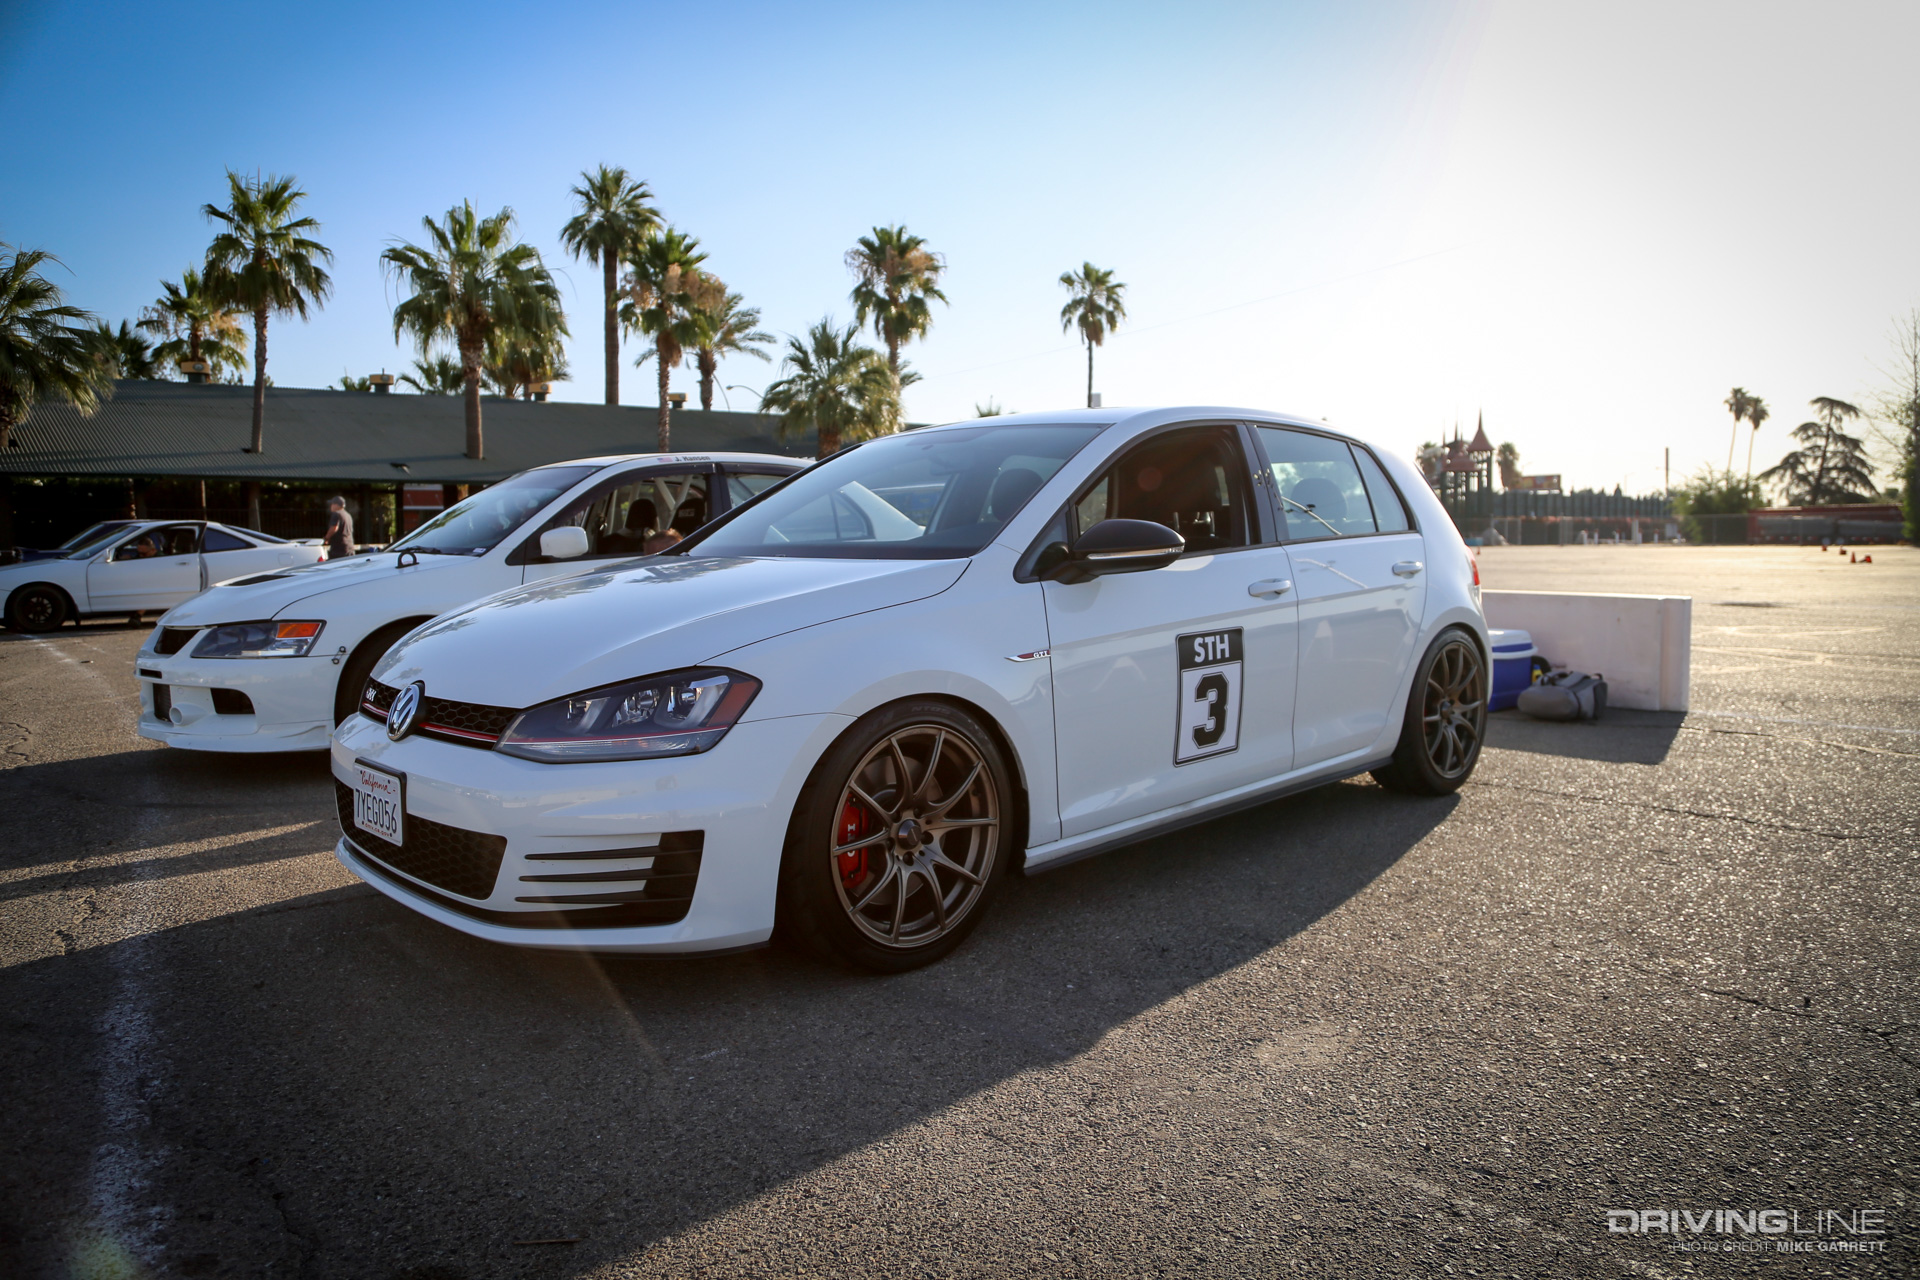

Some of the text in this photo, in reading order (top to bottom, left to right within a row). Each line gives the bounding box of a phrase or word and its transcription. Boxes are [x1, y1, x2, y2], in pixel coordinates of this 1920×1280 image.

[1034, 650, 1049, 658] GTI
[1194, 634, 1230, 663] STH
[1192, 671, 1229, 749] 3
[361, 770, 392, 794] California
[355, 787, 397, 834] 7YEG056
